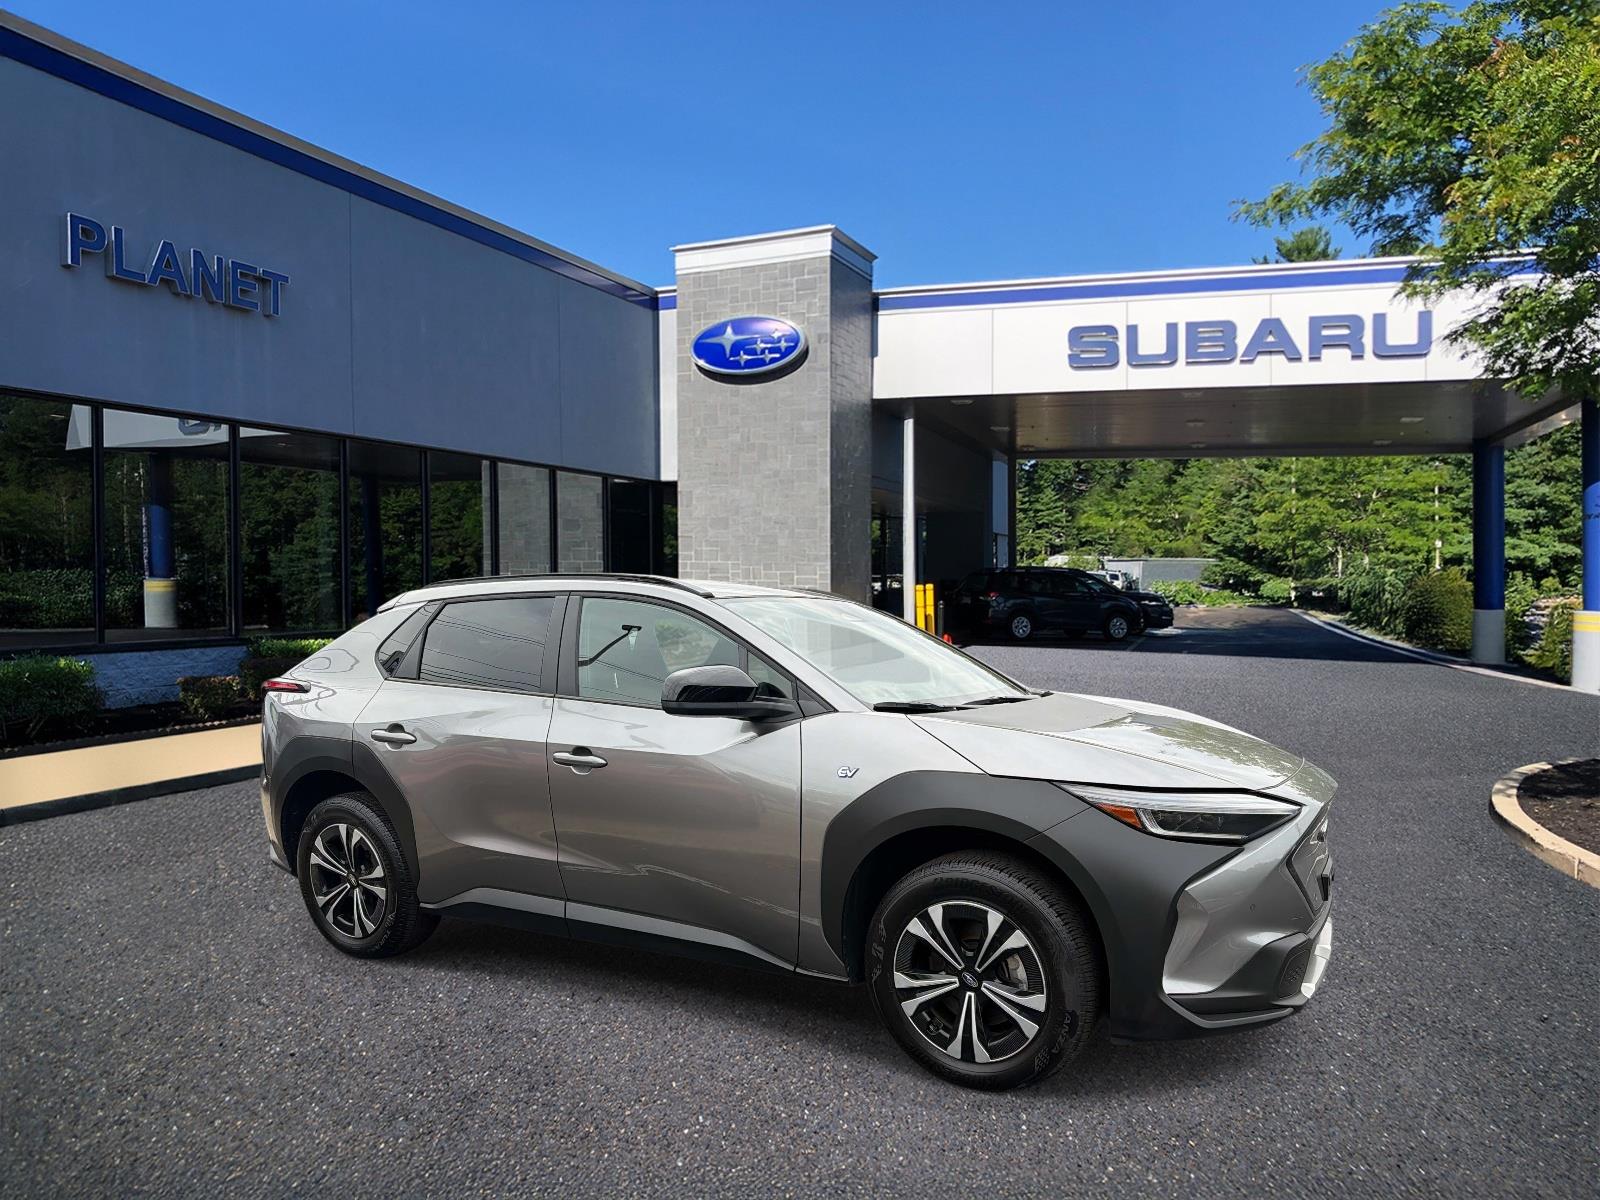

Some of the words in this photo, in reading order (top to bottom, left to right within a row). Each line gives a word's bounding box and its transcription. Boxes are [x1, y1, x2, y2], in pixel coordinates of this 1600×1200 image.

[63, 212, 290, 317] PLANET
[1067, 310, 1433, 369] SUBARU
[837, 765, 860, 779] EV
